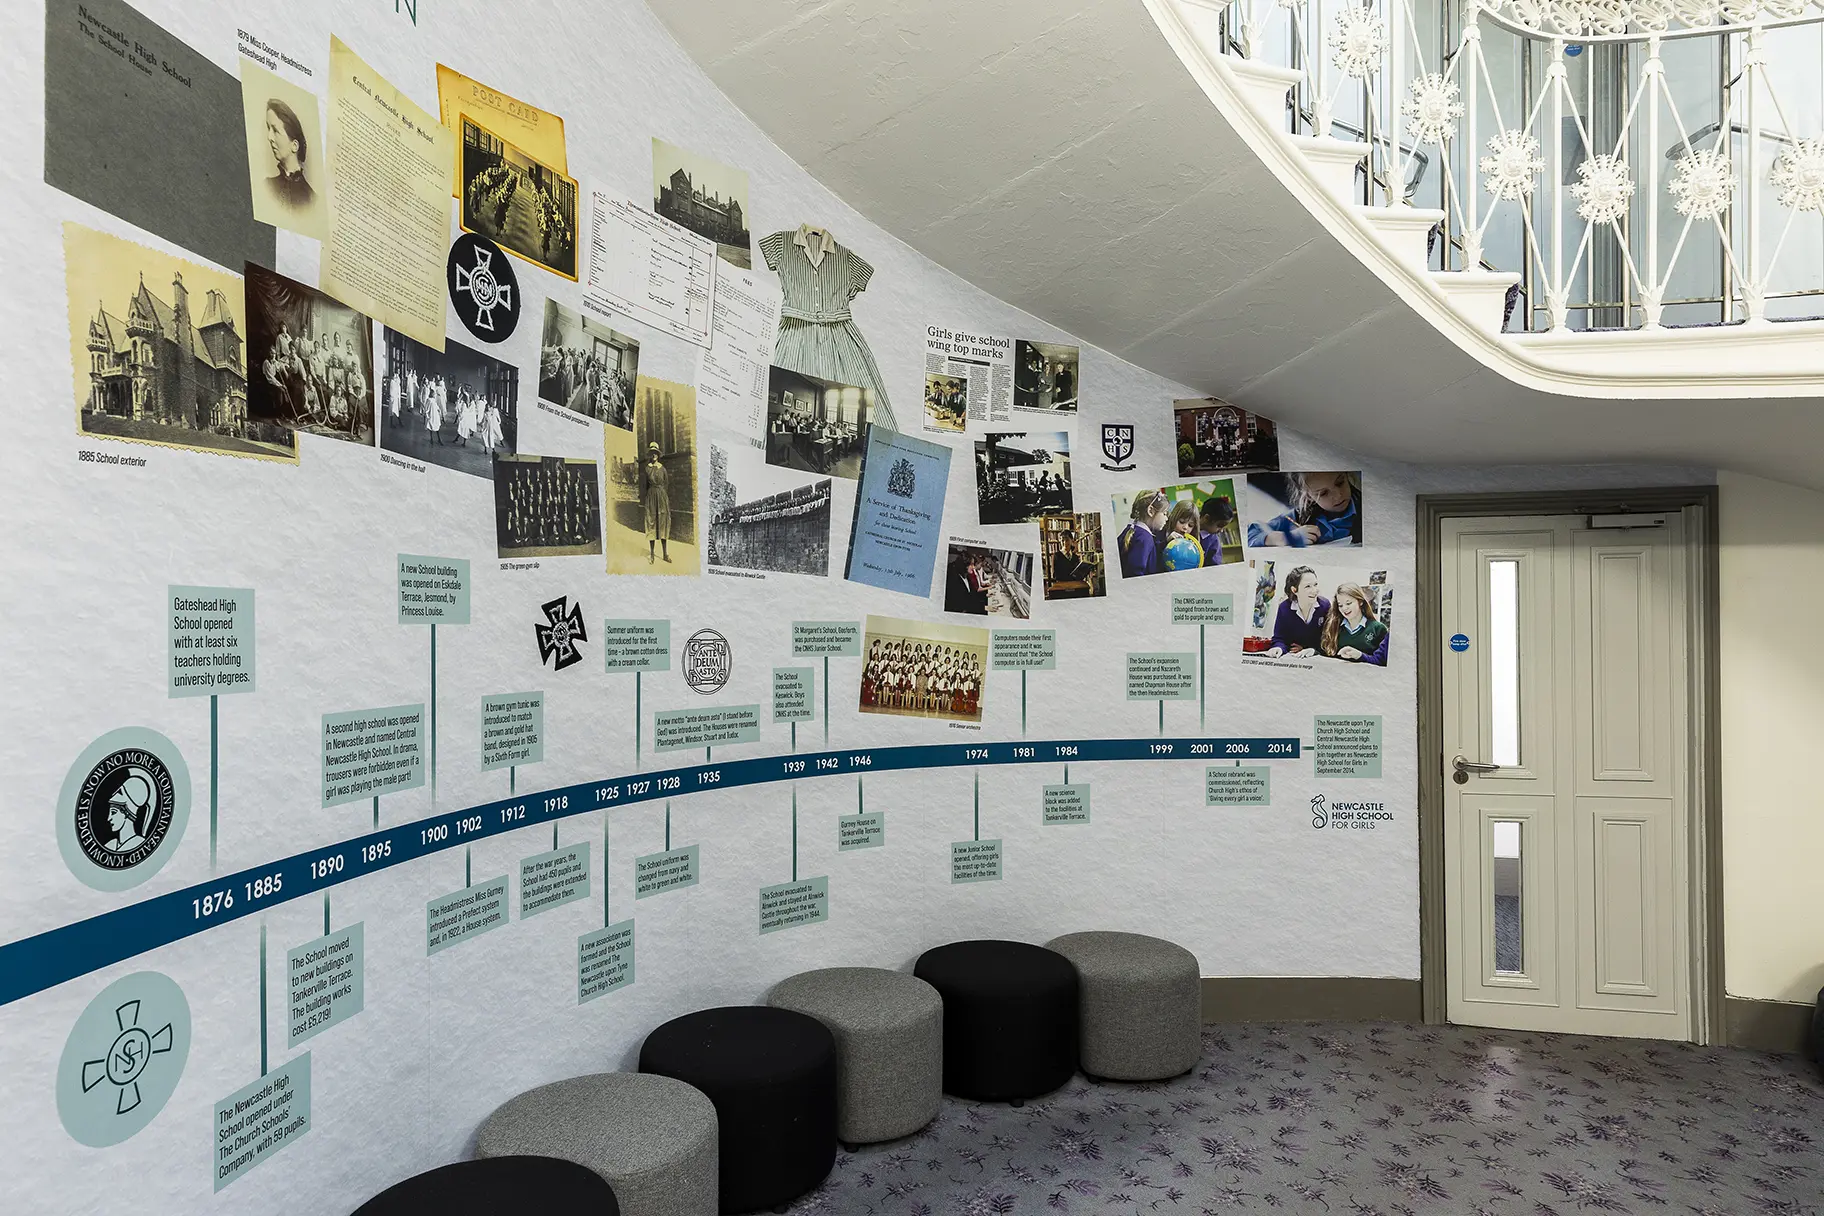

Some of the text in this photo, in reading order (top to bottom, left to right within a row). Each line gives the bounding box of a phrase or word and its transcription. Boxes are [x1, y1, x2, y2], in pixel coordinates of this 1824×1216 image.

[77, 20, 152, 75] The School House
[78, 4, 191, 87] Newcastle High School
[237, 28, 249, 42] 1879
[249, 35, 261, 48] Miss
[280, 52, 312, 76] Headmistress
[237, 42, 277, 70] Gateshead High
[352, 75, 372, 97] Central
[374, 95, 399, 118] Newcastle
[401, 114, 414, 130] High
[927, 326, 1010, 349] Girls give school
[927, 339, 1004, 359] wing top marks
[78, 450, 147, 467] 1885 School exterior
[400, 562, 457, 578] A new School building
[400, 579, 461, 589] was opened on Eskdale
[173, 597, 236, 614] Gateshead High
[401, 591, 456, 604] Terrace, Jesmond, by
[401, 605, 444, 616] Princess Louise.
[173, 616, 233, 631] School opened
[173, 635, 237, 648] with at least six
[174, 652, 241, 667] teachers holding
[696, 658, 719, 667] DEUM
[174, 671, 250, 686] university degrees.
[699, 667, 717, 675] ASTO
[325, 712, 419, 734] A second high school was opened
[1363, 719, 1374, 727] Tyne
[78, 752, 172, 867] KNOWLEDGE IS NOW NO MORE A FOUNTAIN SEALED
[1331, 802, 1384, 811] NEWCASTLE
[1331, 812, 1394, 821] HIGH SCHOOL
[192, 743, 1292, 919] 1876 1885 1890 1895 1900 1902 1912 1918 1925 1927 1928 1935 1939 1942 1946 1974 1981 1984 1999 2001 2006 2014
[1332, 821, 1375, 830] FOR GIRLS
[291, 936, 349, 970] The School moved
[291, 952, 353, 987] to new buildings on
[292, 979, 327, 1003] Tankerville
[292, 984, 351, 1019] The building works
[292, 1020, 307, 1036] cost
[219, 1076, 289, 1123] The Newcastle High
[218, 1089, 293, 1142] School opened under
[219, 1144, 233, 1160] The
[234, 1125, 260, 1150] Church
[256, 1135, 272, 1153] with
[273, 1127, 283, 1142] 59
[283, 1116, 306, 1138] pupils.
